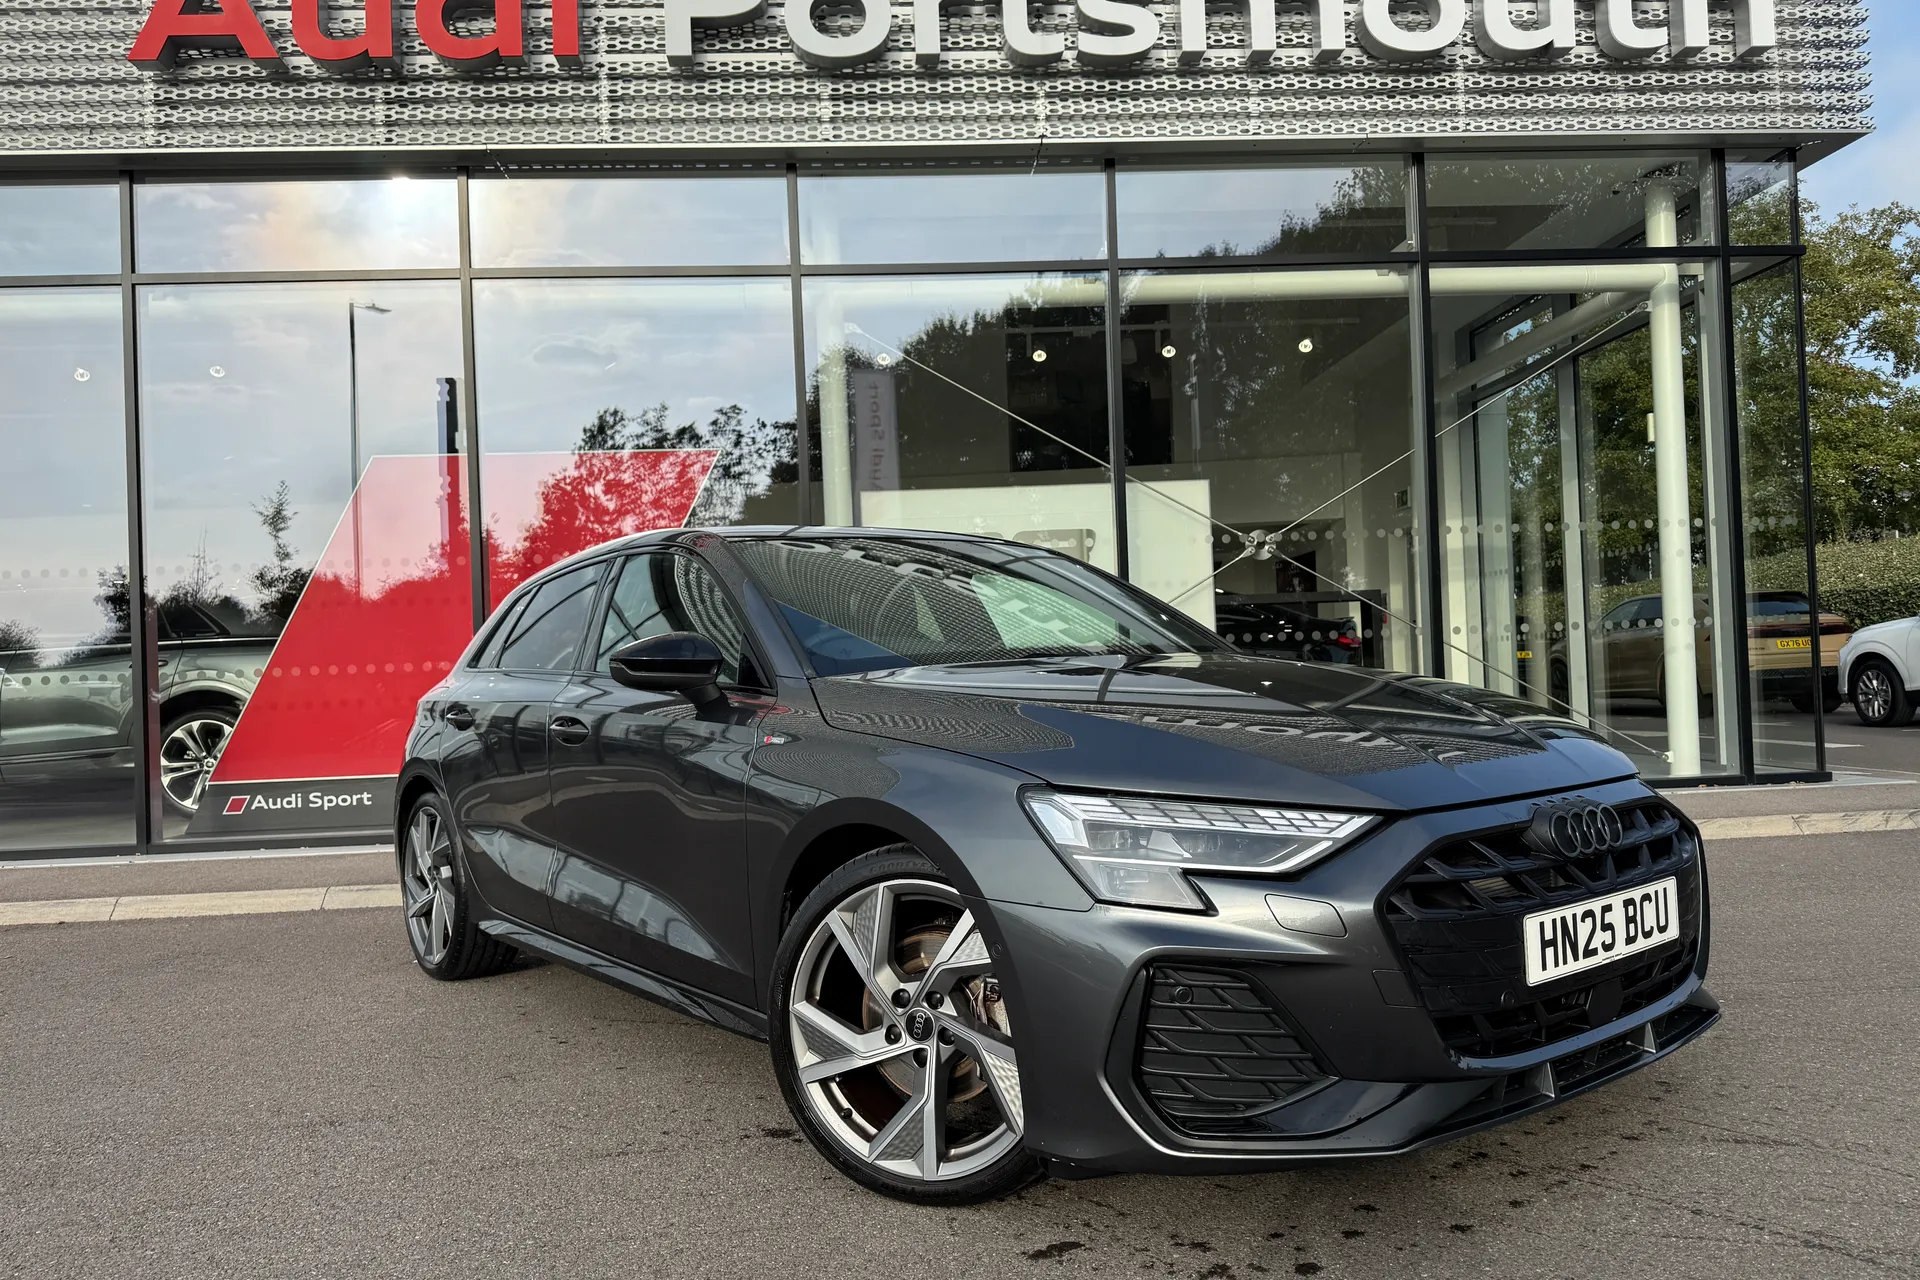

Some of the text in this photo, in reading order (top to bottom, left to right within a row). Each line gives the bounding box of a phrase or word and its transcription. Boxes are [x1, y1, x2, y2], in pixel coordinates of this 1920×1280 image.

[251, 791, 372, 811] Audi Sport
[1539, 886, 1669, 972] HN25 BCU
